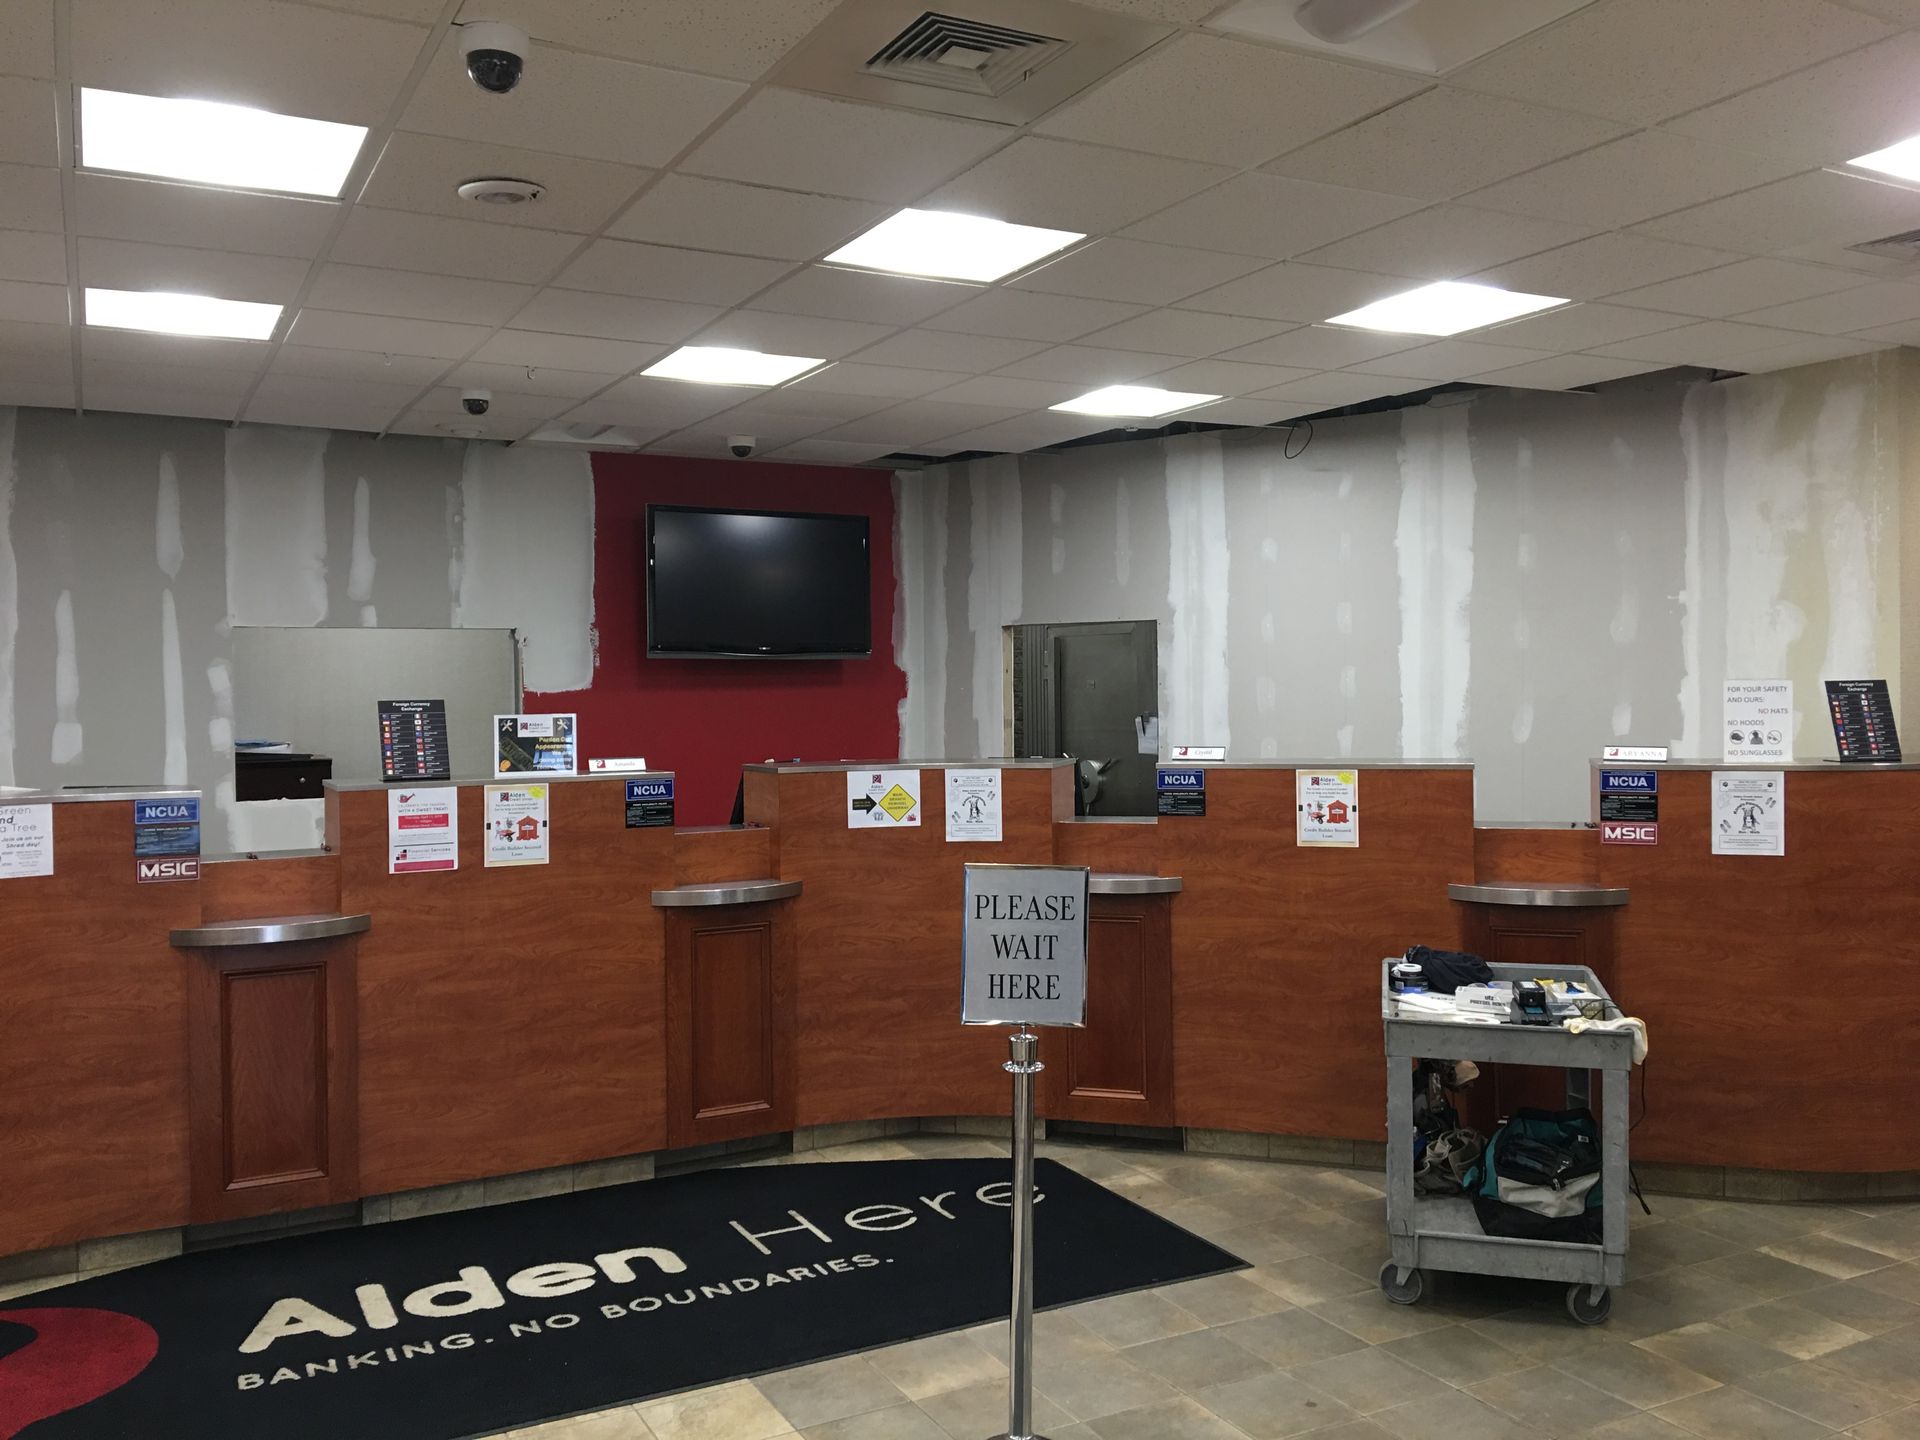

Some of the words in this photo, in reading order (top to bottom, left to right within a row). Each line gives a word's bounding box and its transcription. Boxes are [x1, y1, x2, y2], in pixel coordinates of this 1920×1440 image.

[1763, 685, 1788, 693] SAFETY
[1164, 775, 1197, 785] NCUA
[1609, 776, 1648, 787] NCUA
[633, 785, 667, 796] NCUA
[145, 806, 189, 818] NCUA
[12, 823, 38, 832] Tree
[1604, 826, 1655, 840] MSIC
[140, 861, 197, 878] MSIC
[974, 894, 1076, 921] PLEASE
[991, 934, 1059, 961] WAIT
[988, 974, 1061, 1000] HERE
[238, 1246, 688, 1354] Alden
[729, 1182, 1046, 1255] Here
[237, 1332, 495, 1391] BANKING.
[508, 1313, 581, 1338] NO
[600, 1253, 894, 1320] BOUNDARIES.
